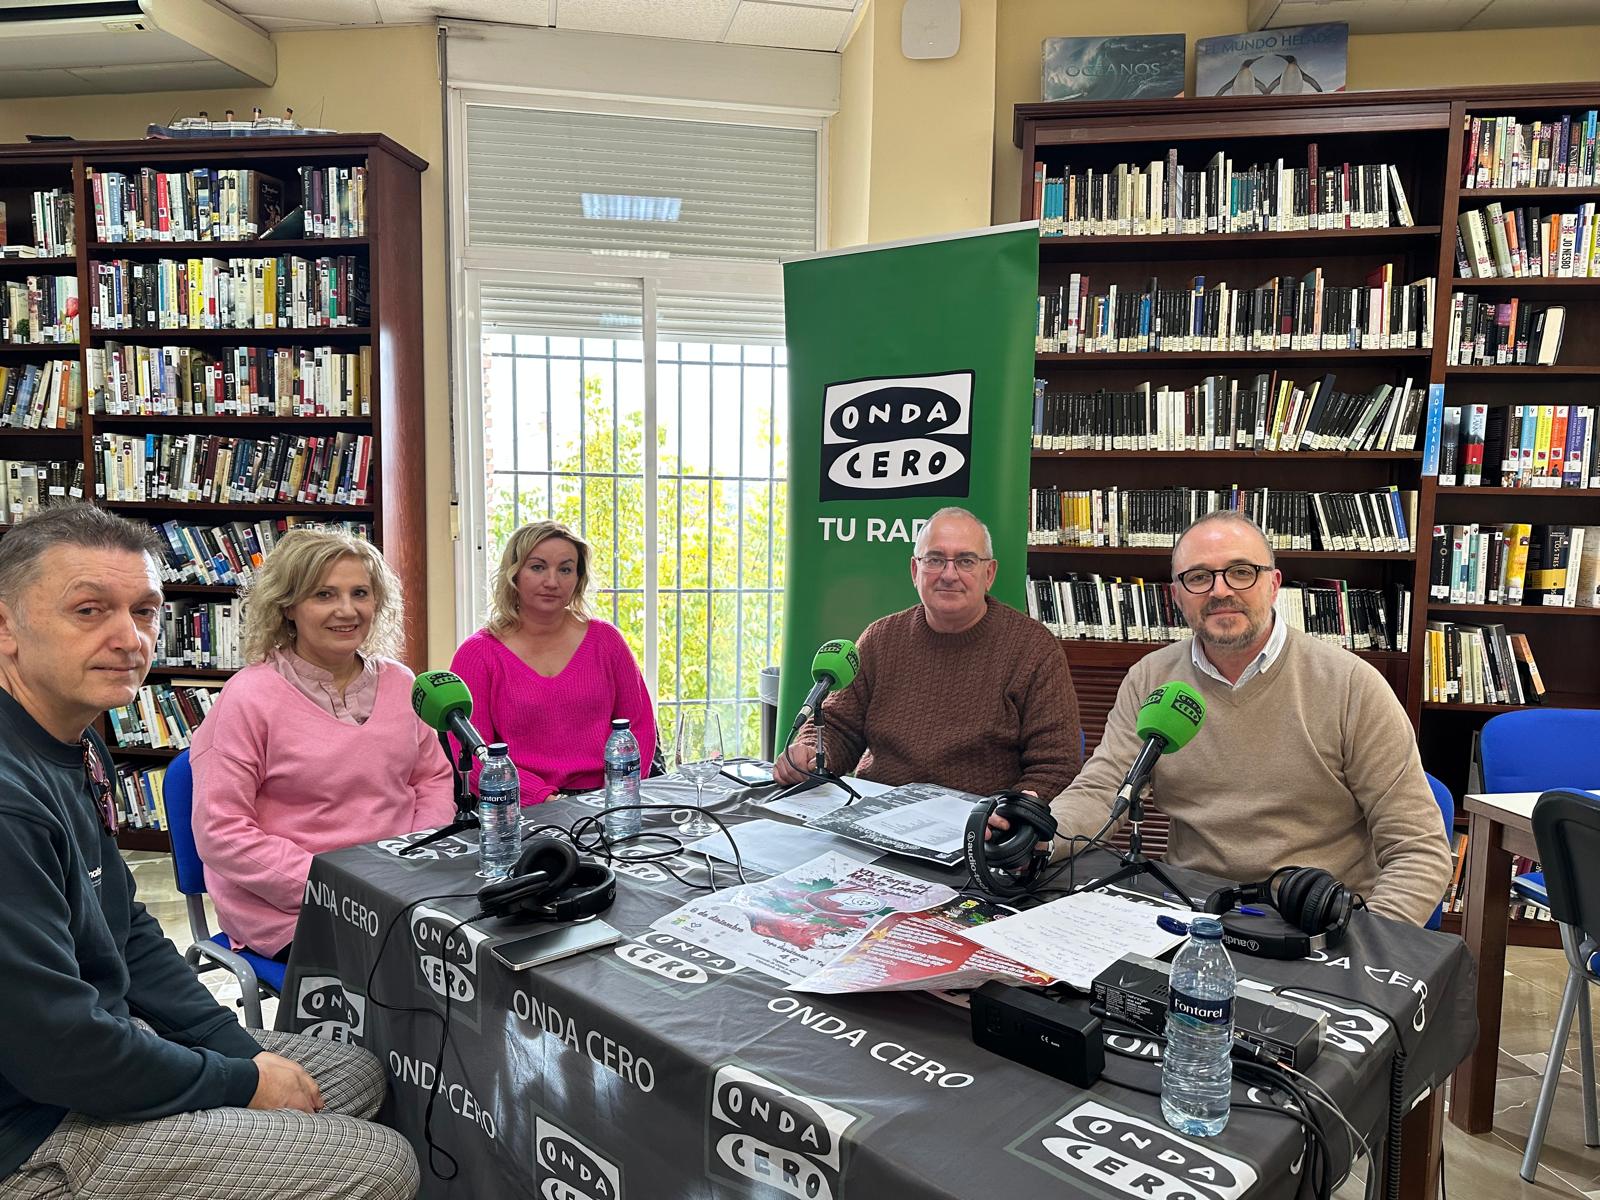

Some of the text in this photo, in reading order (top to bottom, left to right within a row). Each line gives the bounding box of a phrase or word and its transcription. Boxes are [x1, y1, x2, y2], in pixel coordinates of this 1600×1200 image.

[1223, 37, 1277, 53] MUNDO
[1560, 238, 1573, 270] JO NESBO
[842, 401, 948, 429] ONDA
[1429, 383, 1442, 472] NOVEDADES
[846, 449, 947, 479] CERO
[818, 517, 928, 543] TU RAD
[1553, 540, 1561, 554] LOS
[304, 879, 379, 937] NDA CERO
[419, 922, 467, 959] ONDA
[656, 936, 726, 967] ONDA
[625, 945, 700, 980] CERO
[1174, 998, 1223, 1018] Fontarel
[512, 988, 656, 1093] ONDA CERO
[767, 996, 975, 1090] ONDA CERO
[448, 1083, 496, 1140] CERO
[728, 1086, 820, 1149] ONDA
[546, 1141, 608, 1197] ONDA
[730, 1138, 821, 1200] CERO
[1088, 1119, 1217, 1182] ONDA
